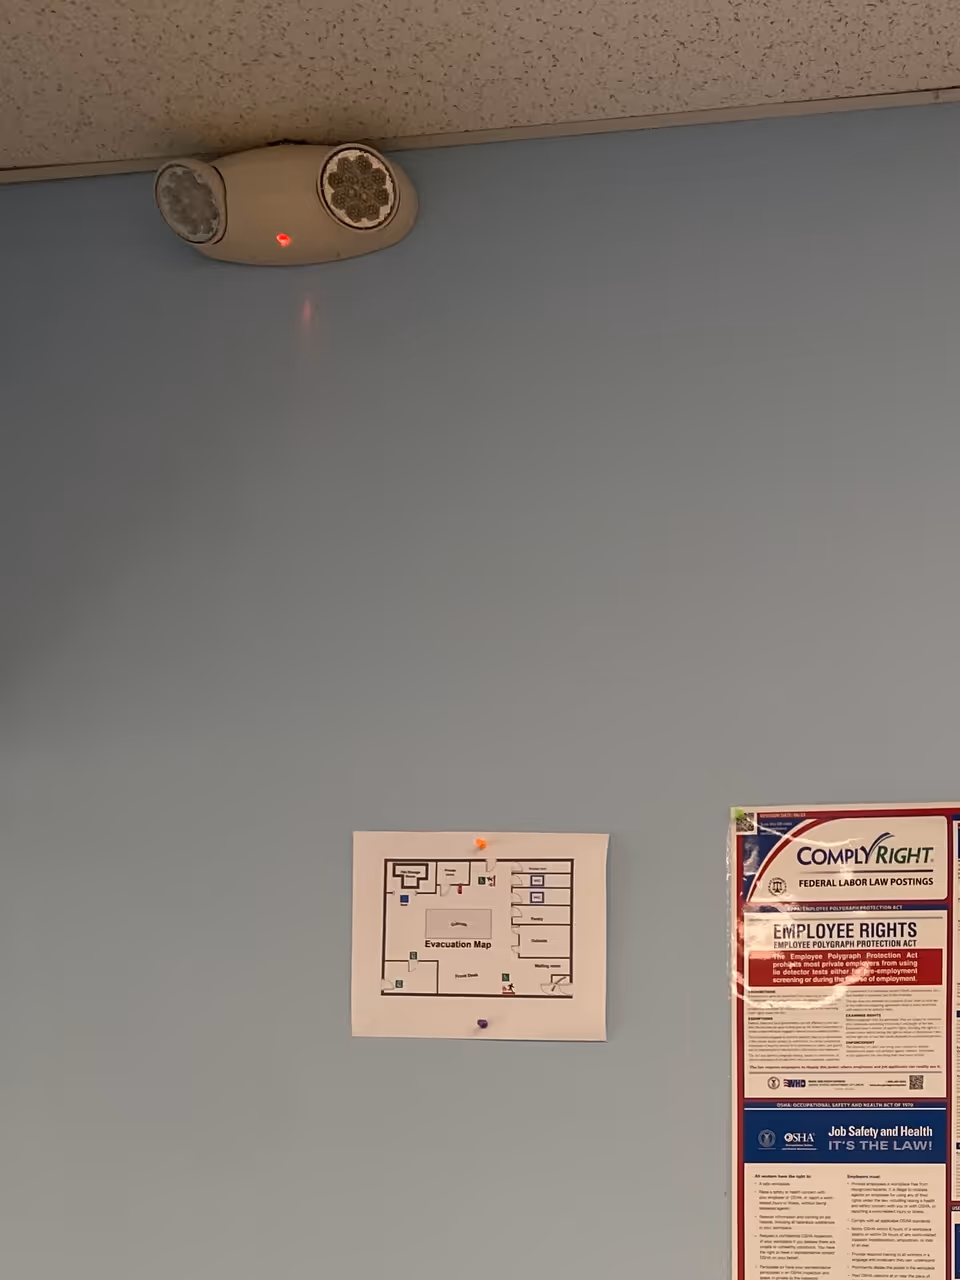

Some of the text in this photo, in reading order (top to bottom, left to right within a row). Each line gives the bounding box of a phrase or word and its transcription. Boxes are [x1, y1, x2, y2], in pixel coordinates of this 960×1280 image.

[799, 878, 934, 887] FEDERAL LABOR LAW POSTINGS
[774, 922, 917, 939] EMPLOYEE RIGHTS
[425, 940, 491, 949] Evacuation Map
[846, 960, 880, 968] employers
[899, 960, 917, 968] using
[788, 1079, 806, 1088] WHD
[828, 1126, 933, 1139] Job Safety and Health
[784, 1133, 815, 1143] OSHA
[828, 1141, 855, 1150] IT'S
[860, 1141, 888, 1150] THE
[893, 1141, 932, 1150] LAW!
